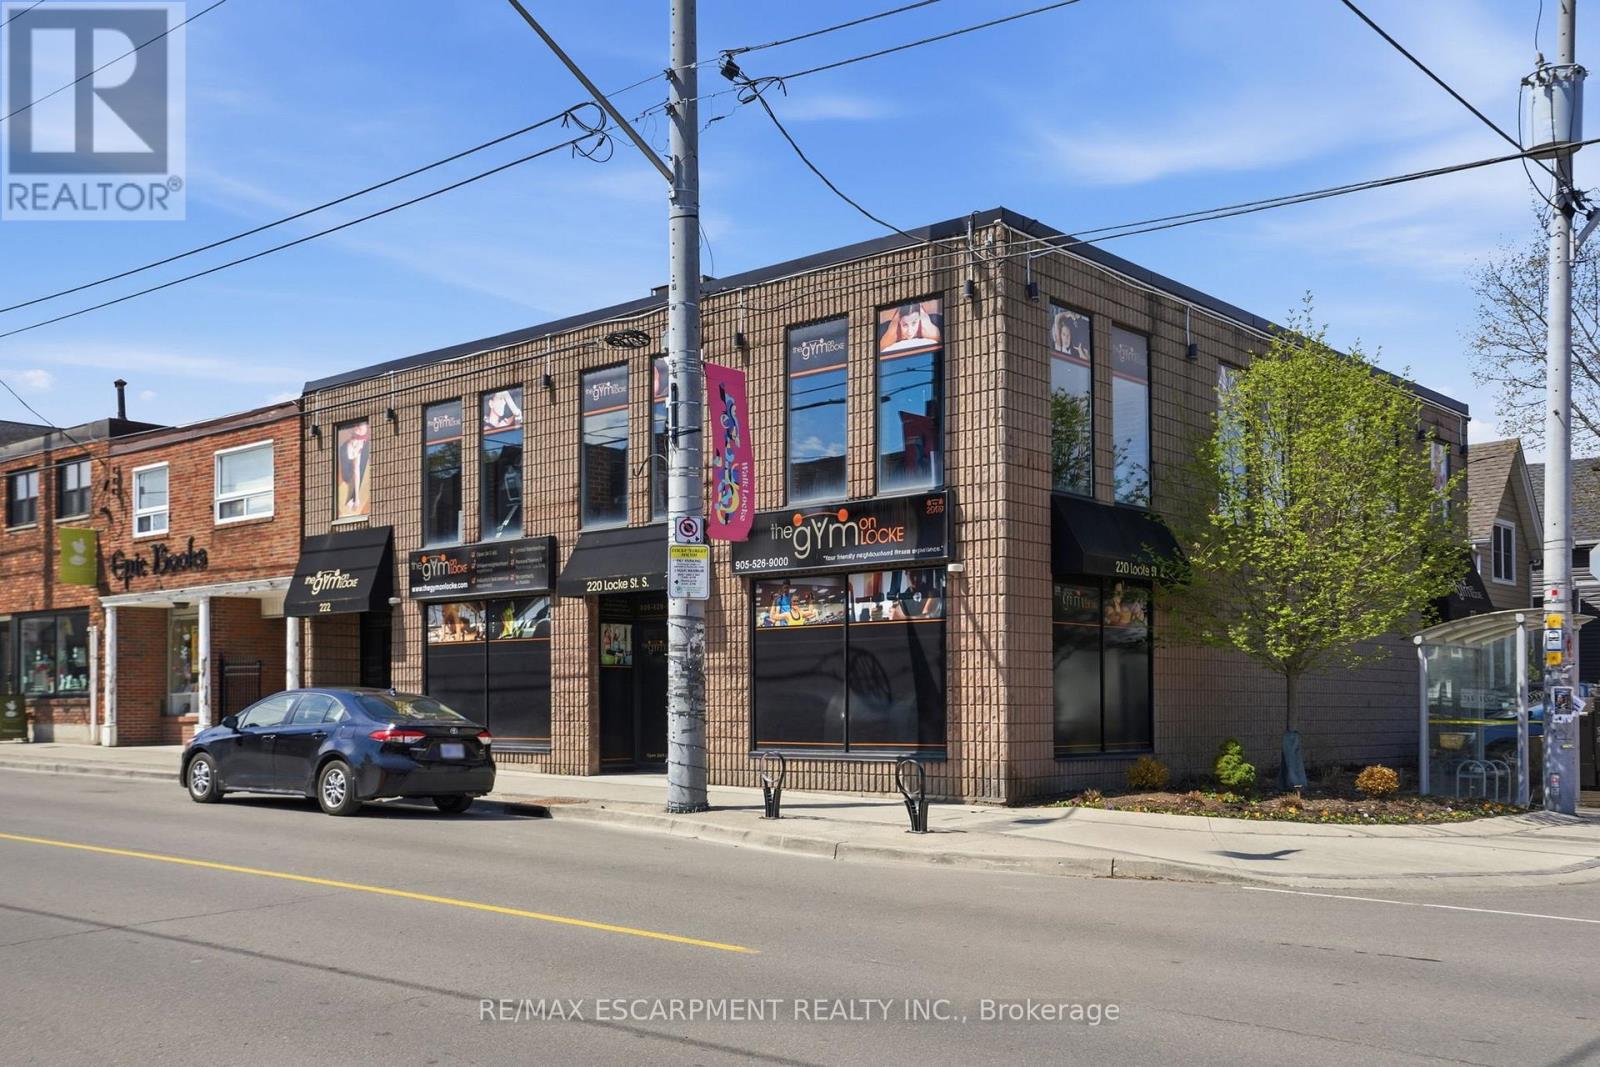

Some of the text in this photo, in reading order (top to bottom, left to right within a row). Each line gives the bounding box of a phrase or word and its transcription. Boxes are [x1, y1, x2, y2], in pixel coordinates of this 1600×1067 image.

[860, 517, 876, 529] on
[770, 523, 793, 540] the
[860, 526, 905, 545] LOCKE
[150, 536, 209, 576] Books
[735, 556, 789, 570] 905-526-9000
[1116, 561, 1129, 574] 220
[587, 580, 602, 592] 220
[604, 579, 628, 590] Locke
[642, 576, 650, 588] S.
[320, 602, 332, 612] 222
